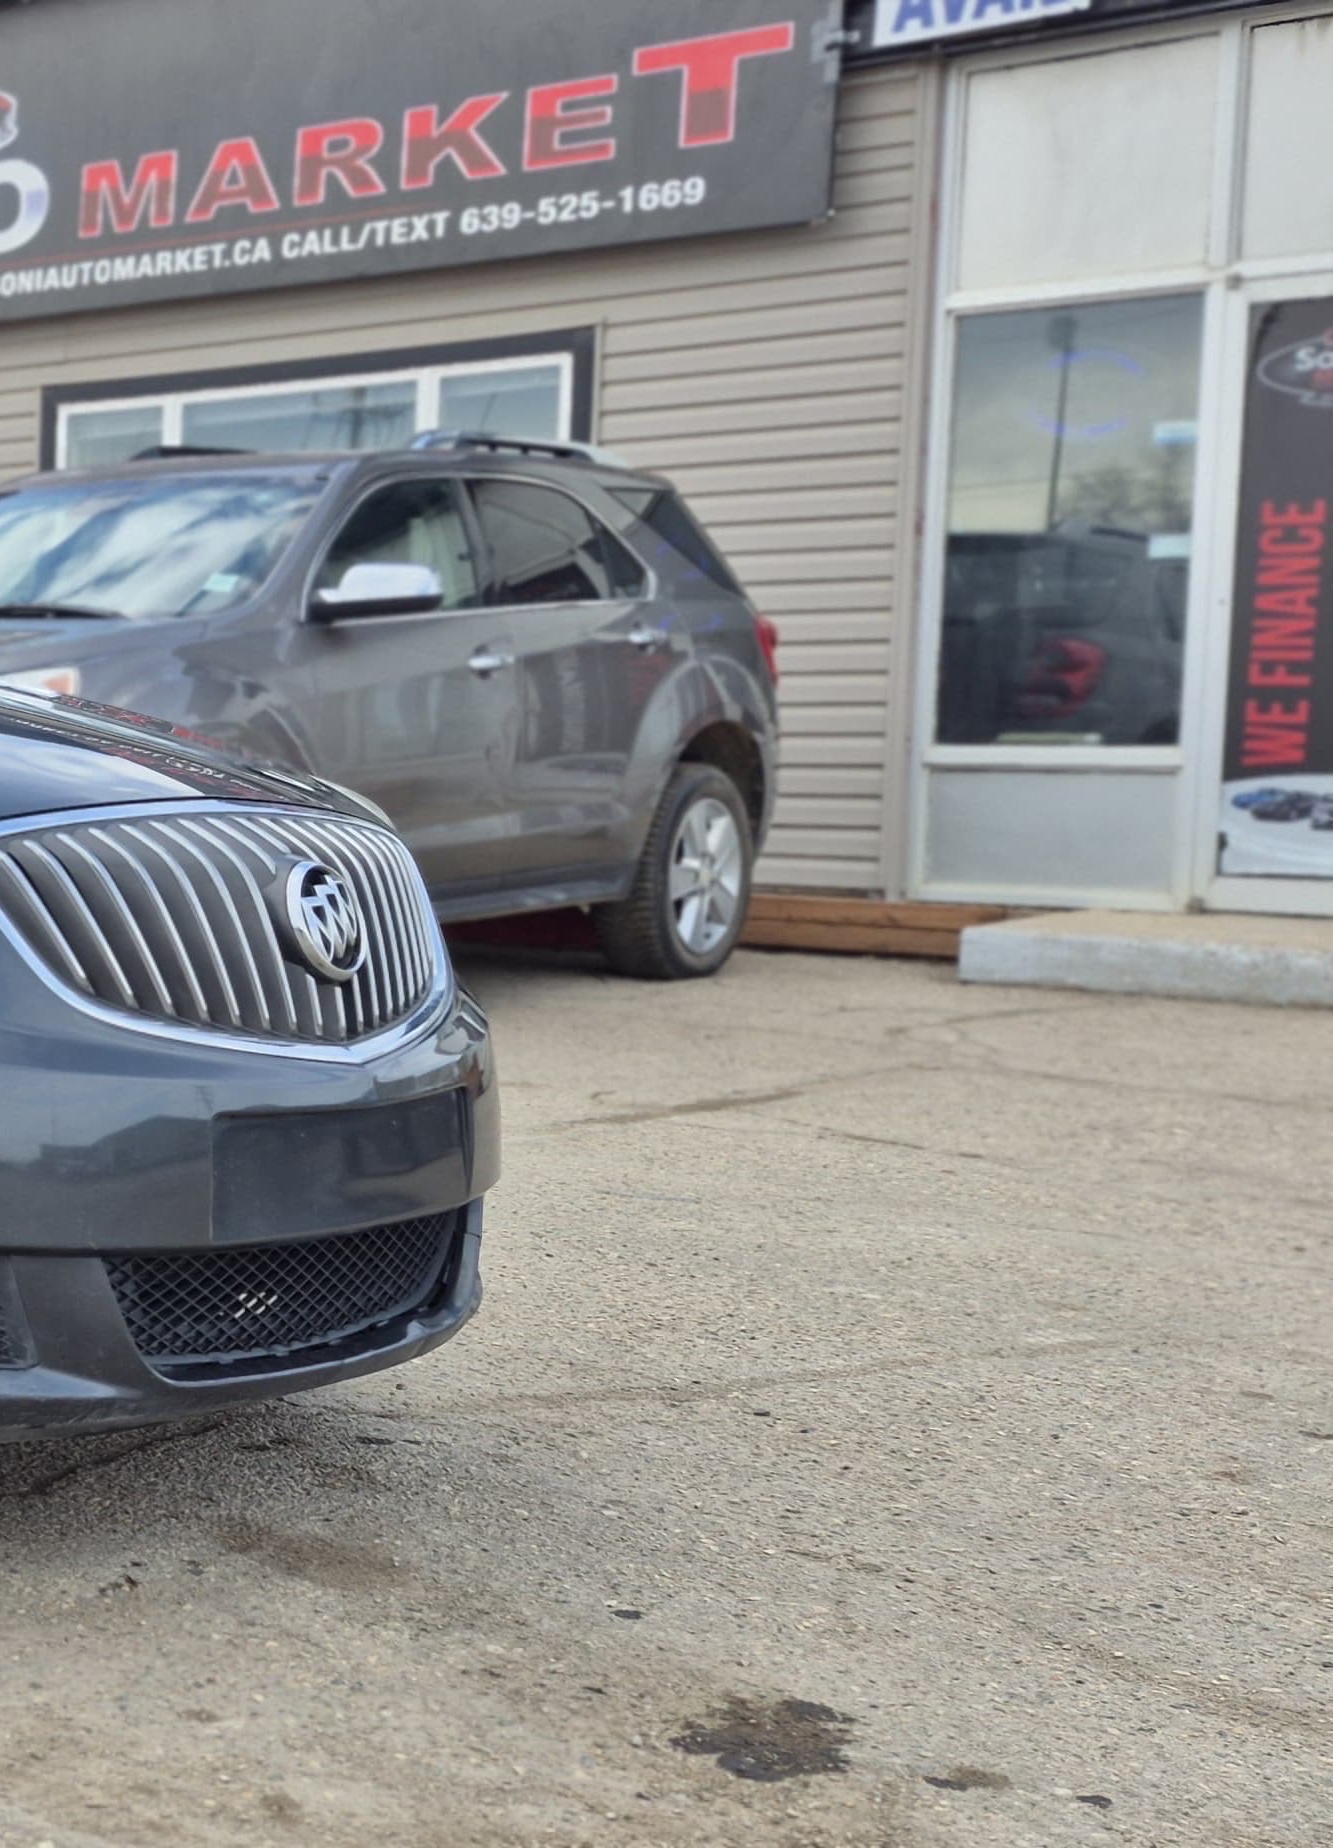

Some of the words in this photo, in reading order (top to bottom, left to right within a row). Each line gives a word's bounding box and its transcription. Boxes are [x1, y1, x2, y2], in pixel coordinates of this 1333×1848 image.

[77, 21, 795, 238] MARKET
[281, 211, 450, 258] CALL/TEXT
[460, 176, 706, 234] 639-525-1669
[1247, 499, 1328, 690] FINANCE
[1241, 699, 1310, 767] WE
